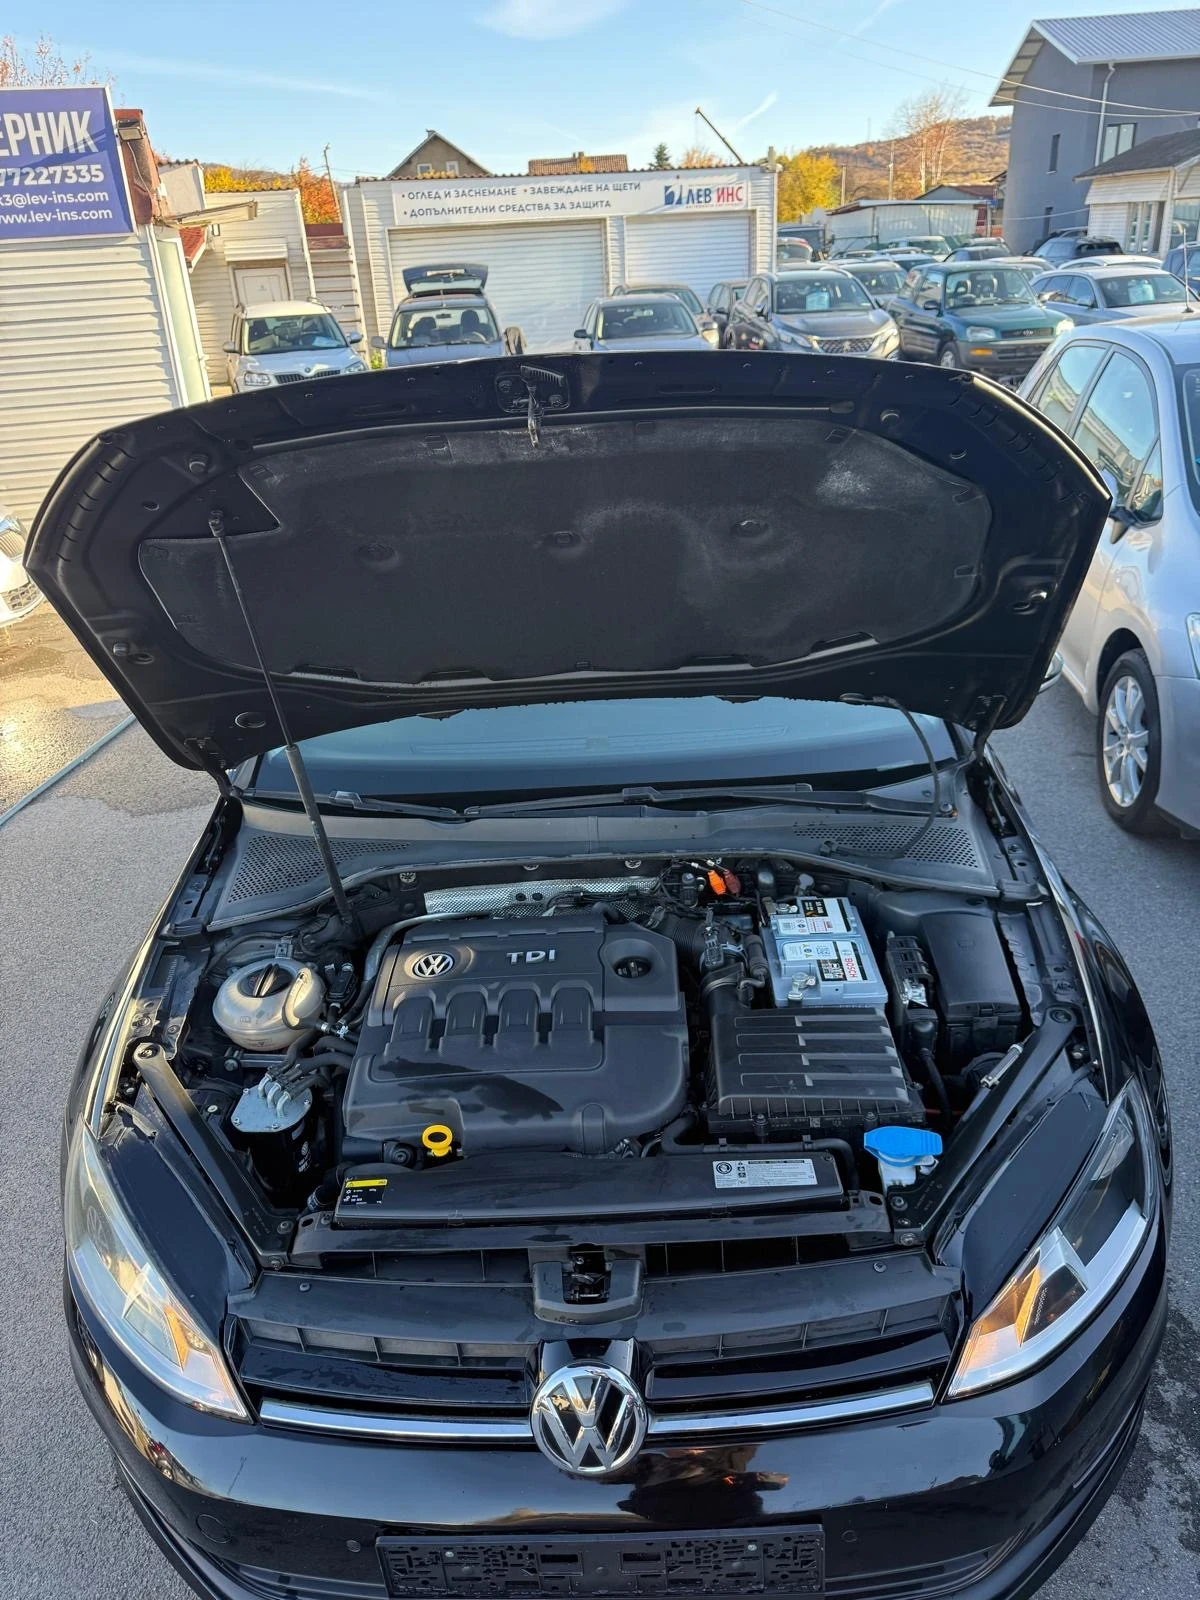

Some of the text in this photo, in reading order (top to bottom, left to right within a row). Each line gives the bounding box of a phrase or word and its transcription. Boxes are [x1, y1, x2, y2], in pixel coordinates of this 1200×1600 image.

[408, 182, 641, 200] ОГЛЕД И ЗАСНЕМАНЕ ЗАВЕЖДАНЕ НА ЩЕТИ
[686, 186, 743, 204] ЛЕВ ИНС
[0, 209, 112, 224] ww.lev-ins.com
[410, 200, 611, 218] ДОПЪЛНИТЕЛНИ СРЕДСТВА ЗА ЗАЩИТА
[506, 950, 555, 964] TDI
[845, 958, 857, 978] BOSCH
